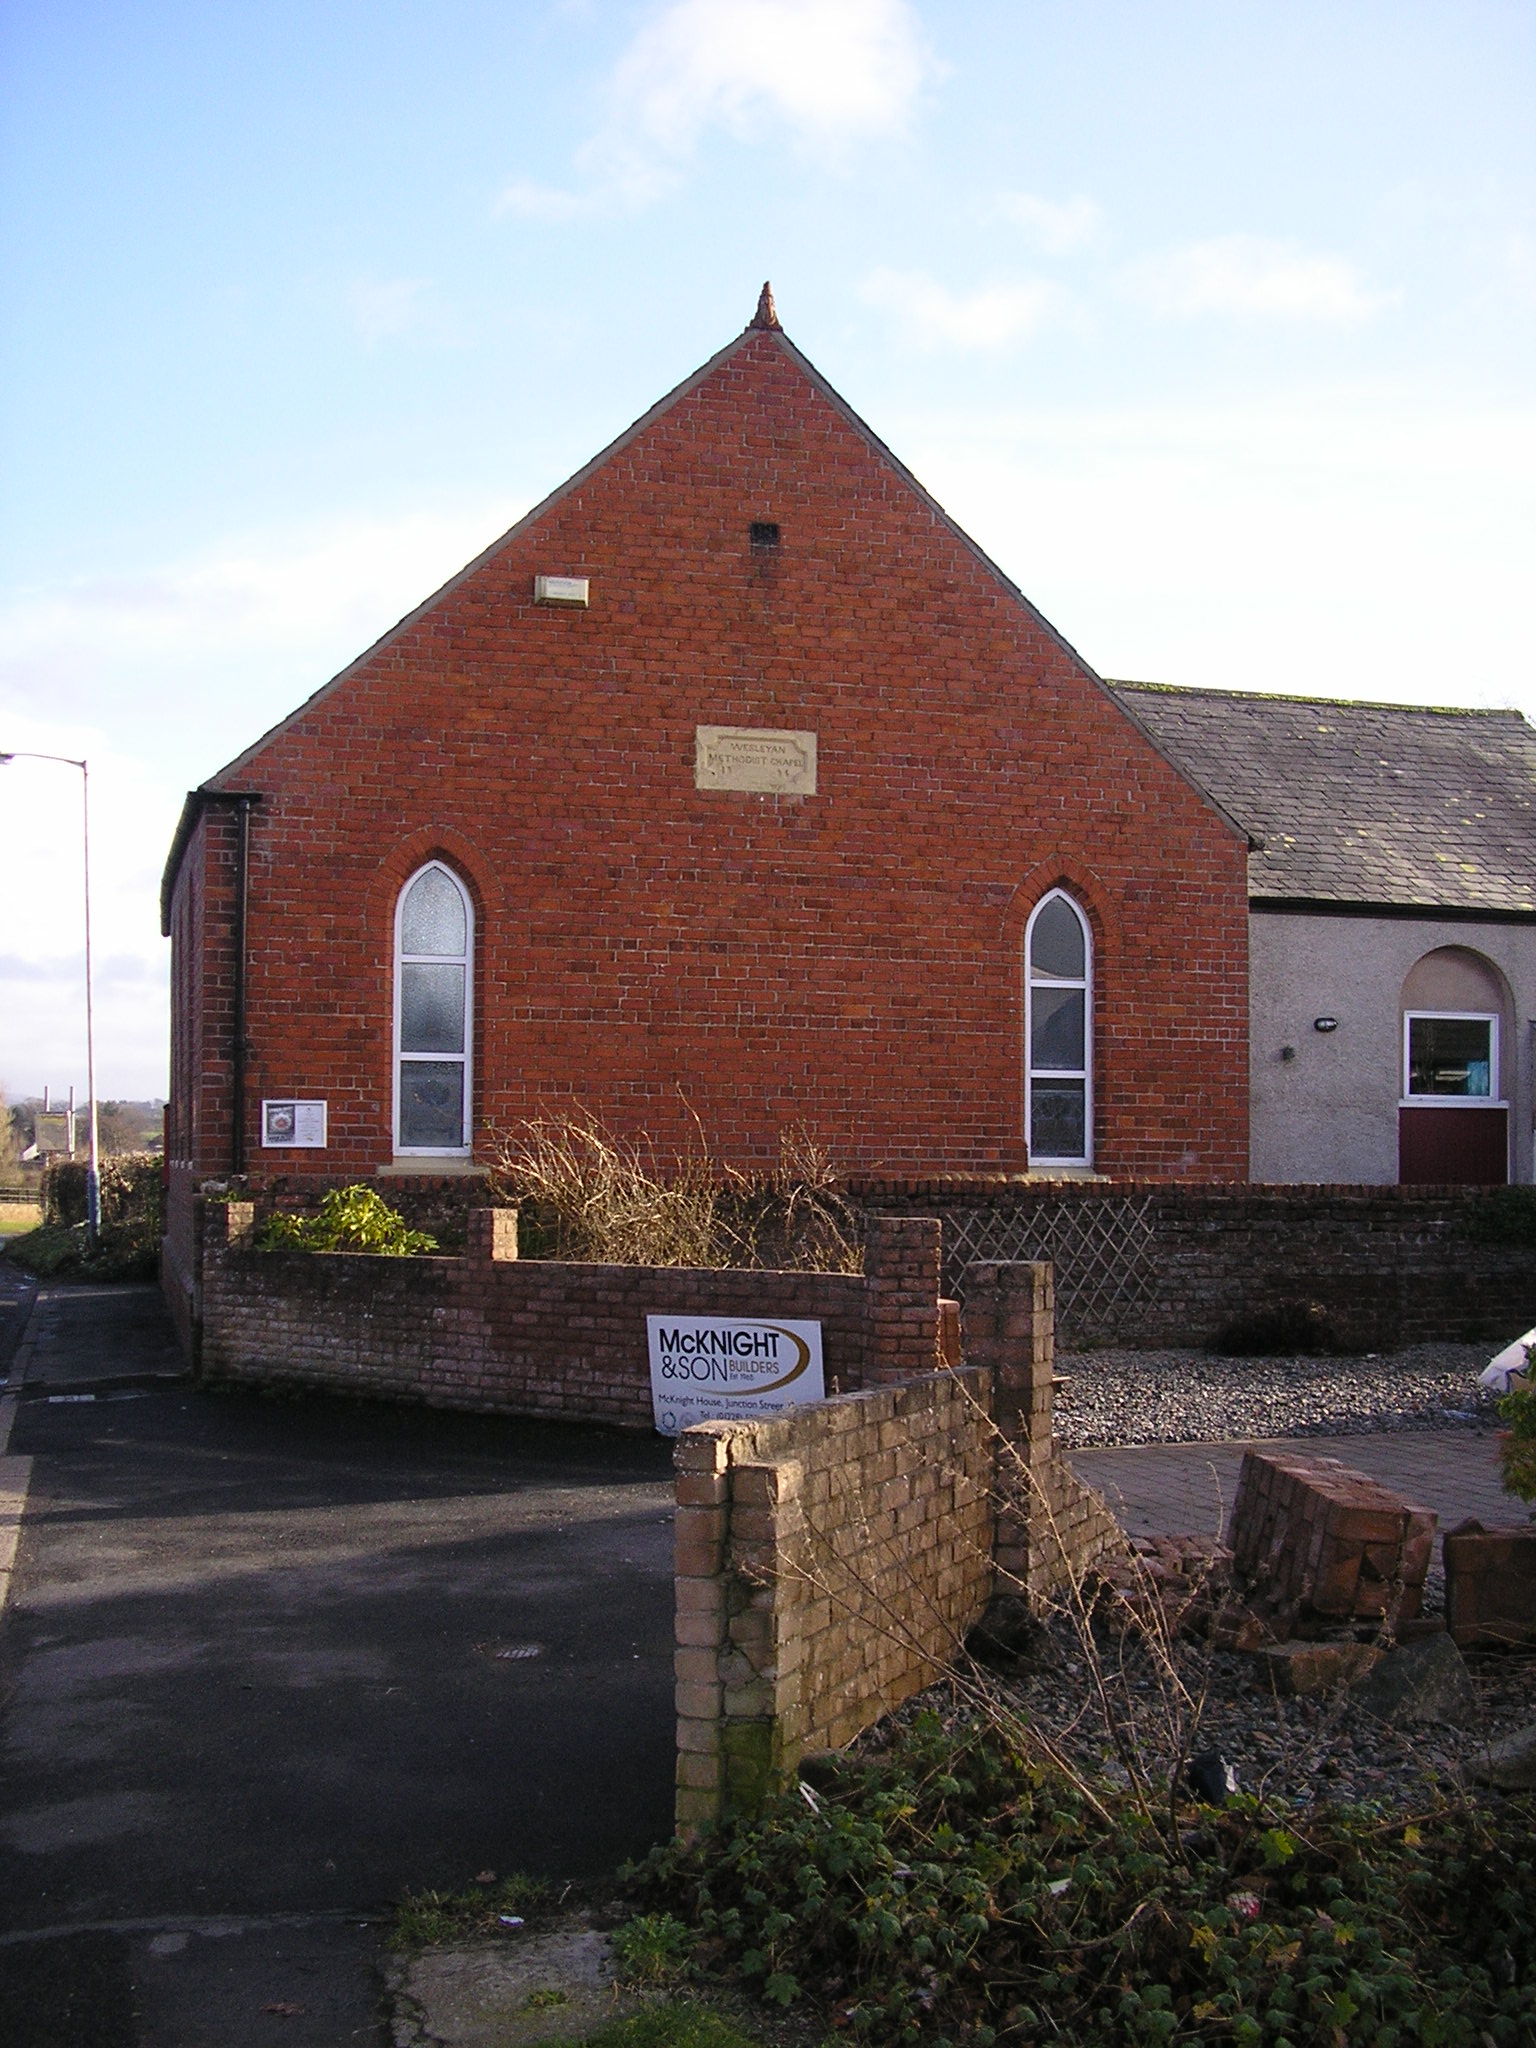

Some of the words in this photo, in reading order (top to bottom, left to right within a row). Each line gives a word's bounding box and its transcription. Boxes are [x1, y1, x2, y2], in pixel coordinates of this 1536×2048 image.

[731, 743, 786, 754] WESLEYAN
[708, 753, 767, 765] METHODIST
[769, 756, 804, 767] CHAPEL
[659, 1328, 780, 1358] McKNIGHT
[729, 1359, 780, 1374] BUILDERS
[658, 1394, 694, 1408] McKnight
[724, 1398, 758, 1410] Junction
